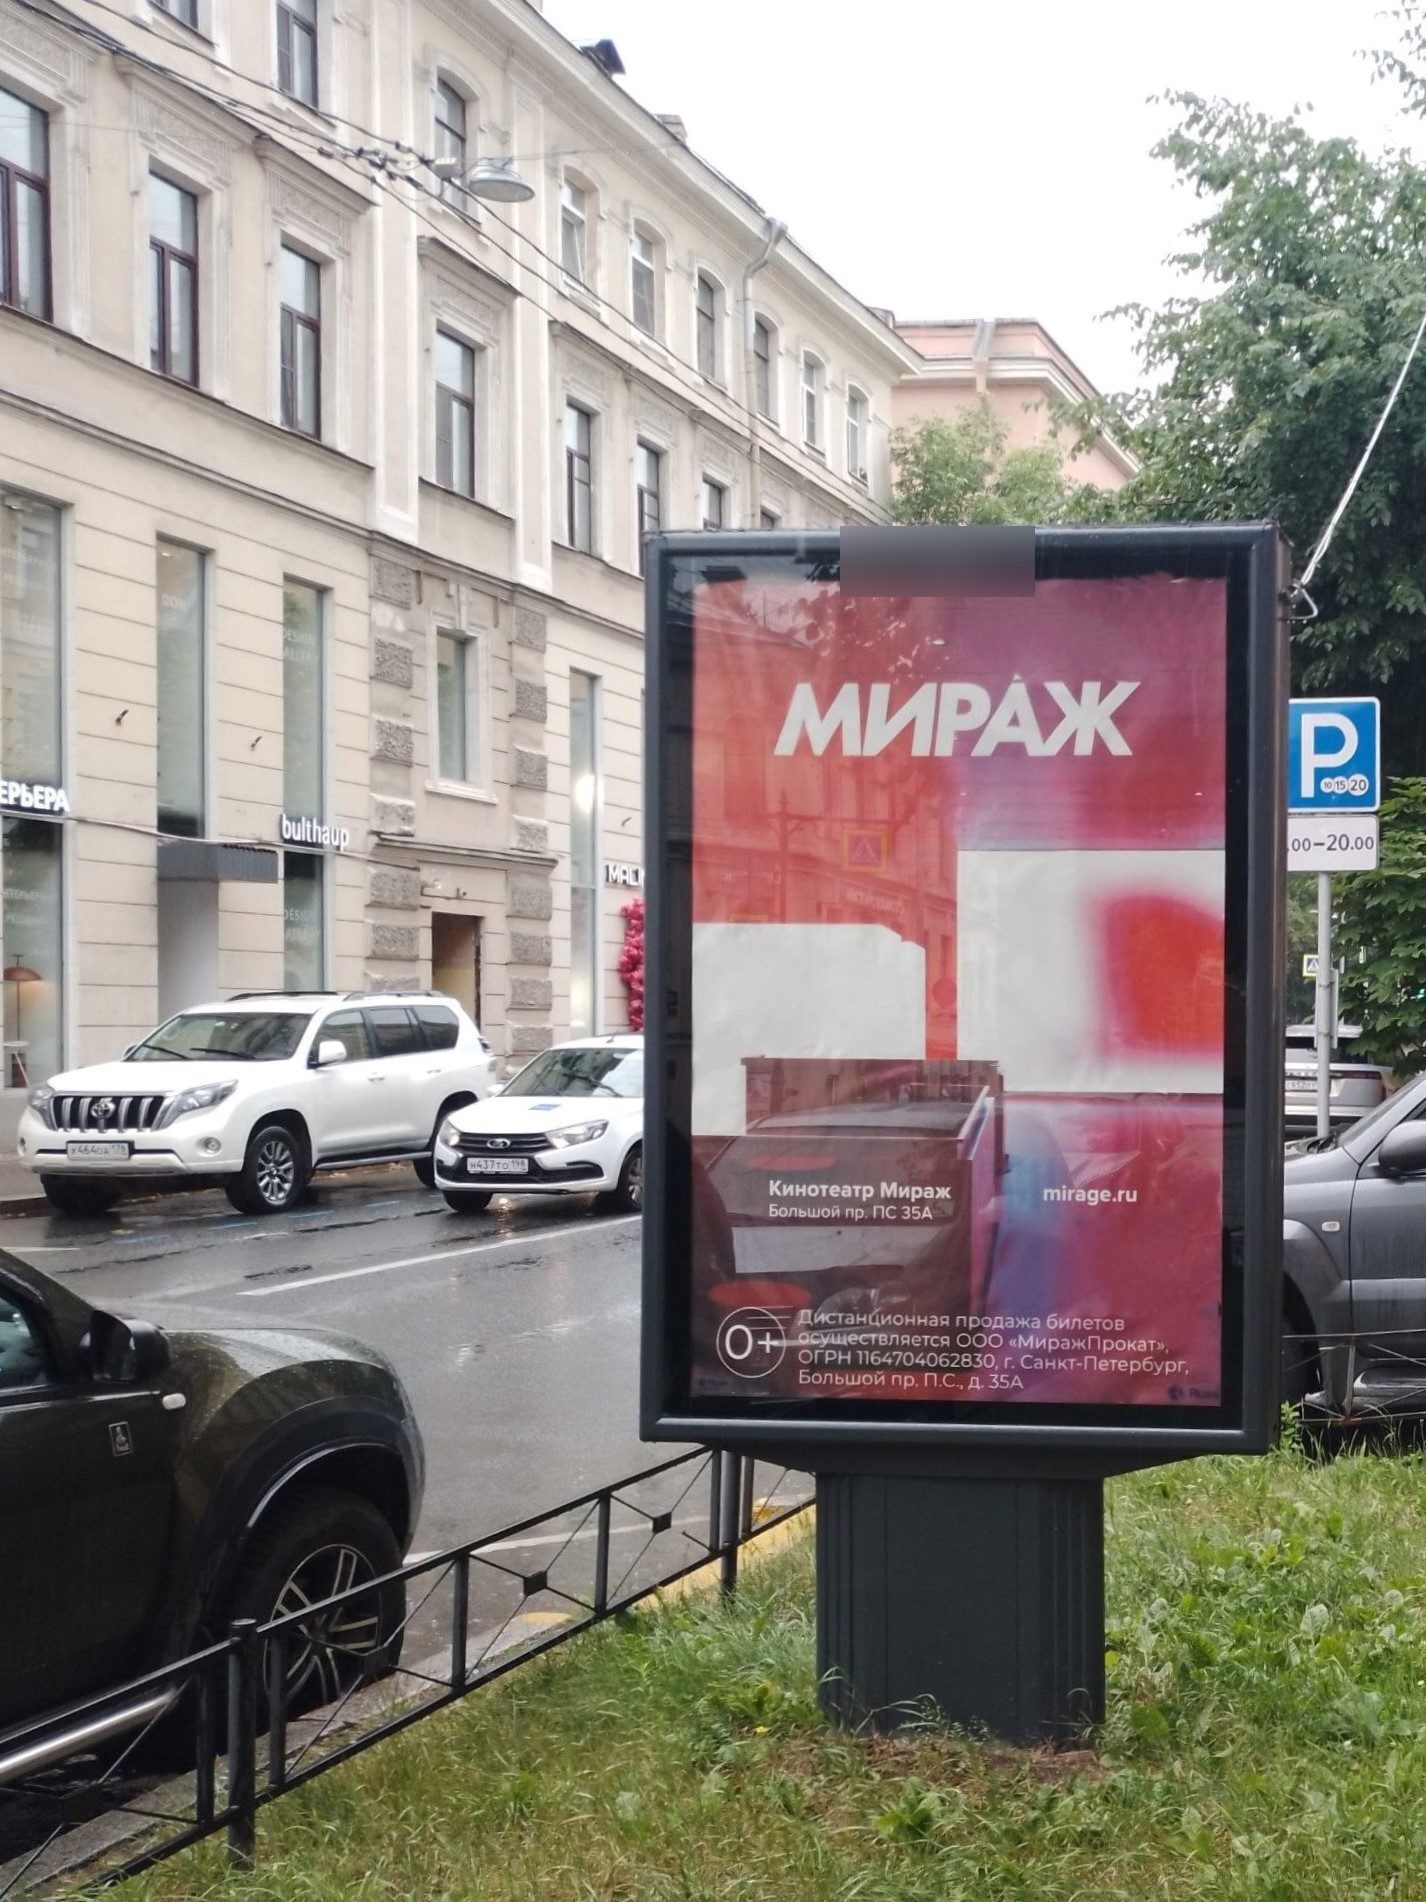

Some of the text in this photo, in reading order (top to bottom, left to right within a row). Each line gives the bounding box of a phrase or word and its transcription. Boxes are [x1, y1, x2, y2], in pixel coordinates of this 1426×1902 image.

[774, 675, 1141, 757] МИРАЖ
[1350, 779, 1367, 791] 20
[281, 813, 350, 852] bulthaup
[769, 1180, 952, 1202] Кинотеатр Мираж
[1043, 1184, 1138, 1206] mirage.ru
[769, 1203, 934, 1222] Большой пр. ПС 35А
[797, 1309, 1125, 1331] Дистанционная продажа билетов
[725, 1324, 779, 1360] 0+
[798, 1331, 950, 1348] осуществляется
[956, 1332, 1004, 1348] ООО
[798, 1349, 851, 1365] ОГРН
[1004, 1357, 1015, 1370] г.
[1020, 1355, 1190, 1376] Санкт-Петербург,
[798, 1369, 885, 1386] Большой
[891, 1374, 919, 1390] пр.
[968, 1375, 984, 1391] д.
[989, 1374, 1024, 1390] 35А
